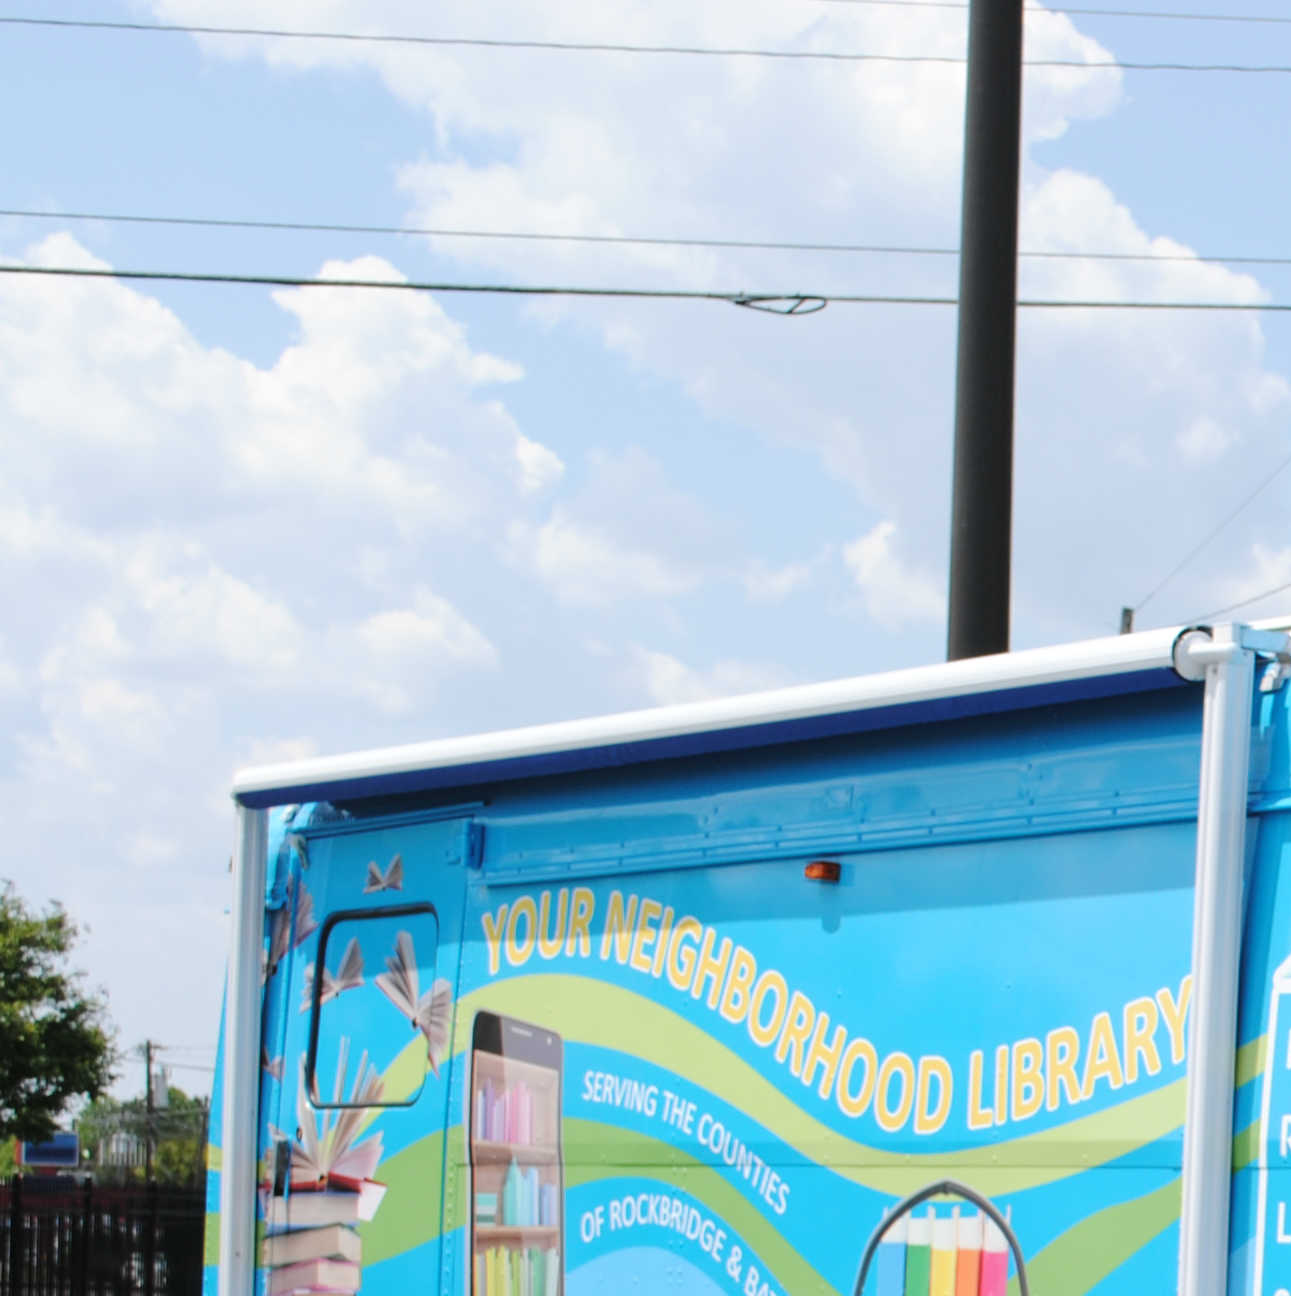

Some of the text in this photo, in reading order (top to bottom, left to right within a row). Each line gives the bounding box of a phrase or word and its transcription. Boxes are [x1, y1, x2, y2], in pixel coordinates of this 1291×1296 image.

[481, 887, 1193, 1135] YOUR NEIGHBORHOOD LIBRARY
[581, 1069, 791, 1216] SERVING THE COUNTIES
[580, 1206, 605, 1244] OF
[609, 1194, 727, 1263] ROCKBRIDGE
[726, 1245, 743, 1283] &
